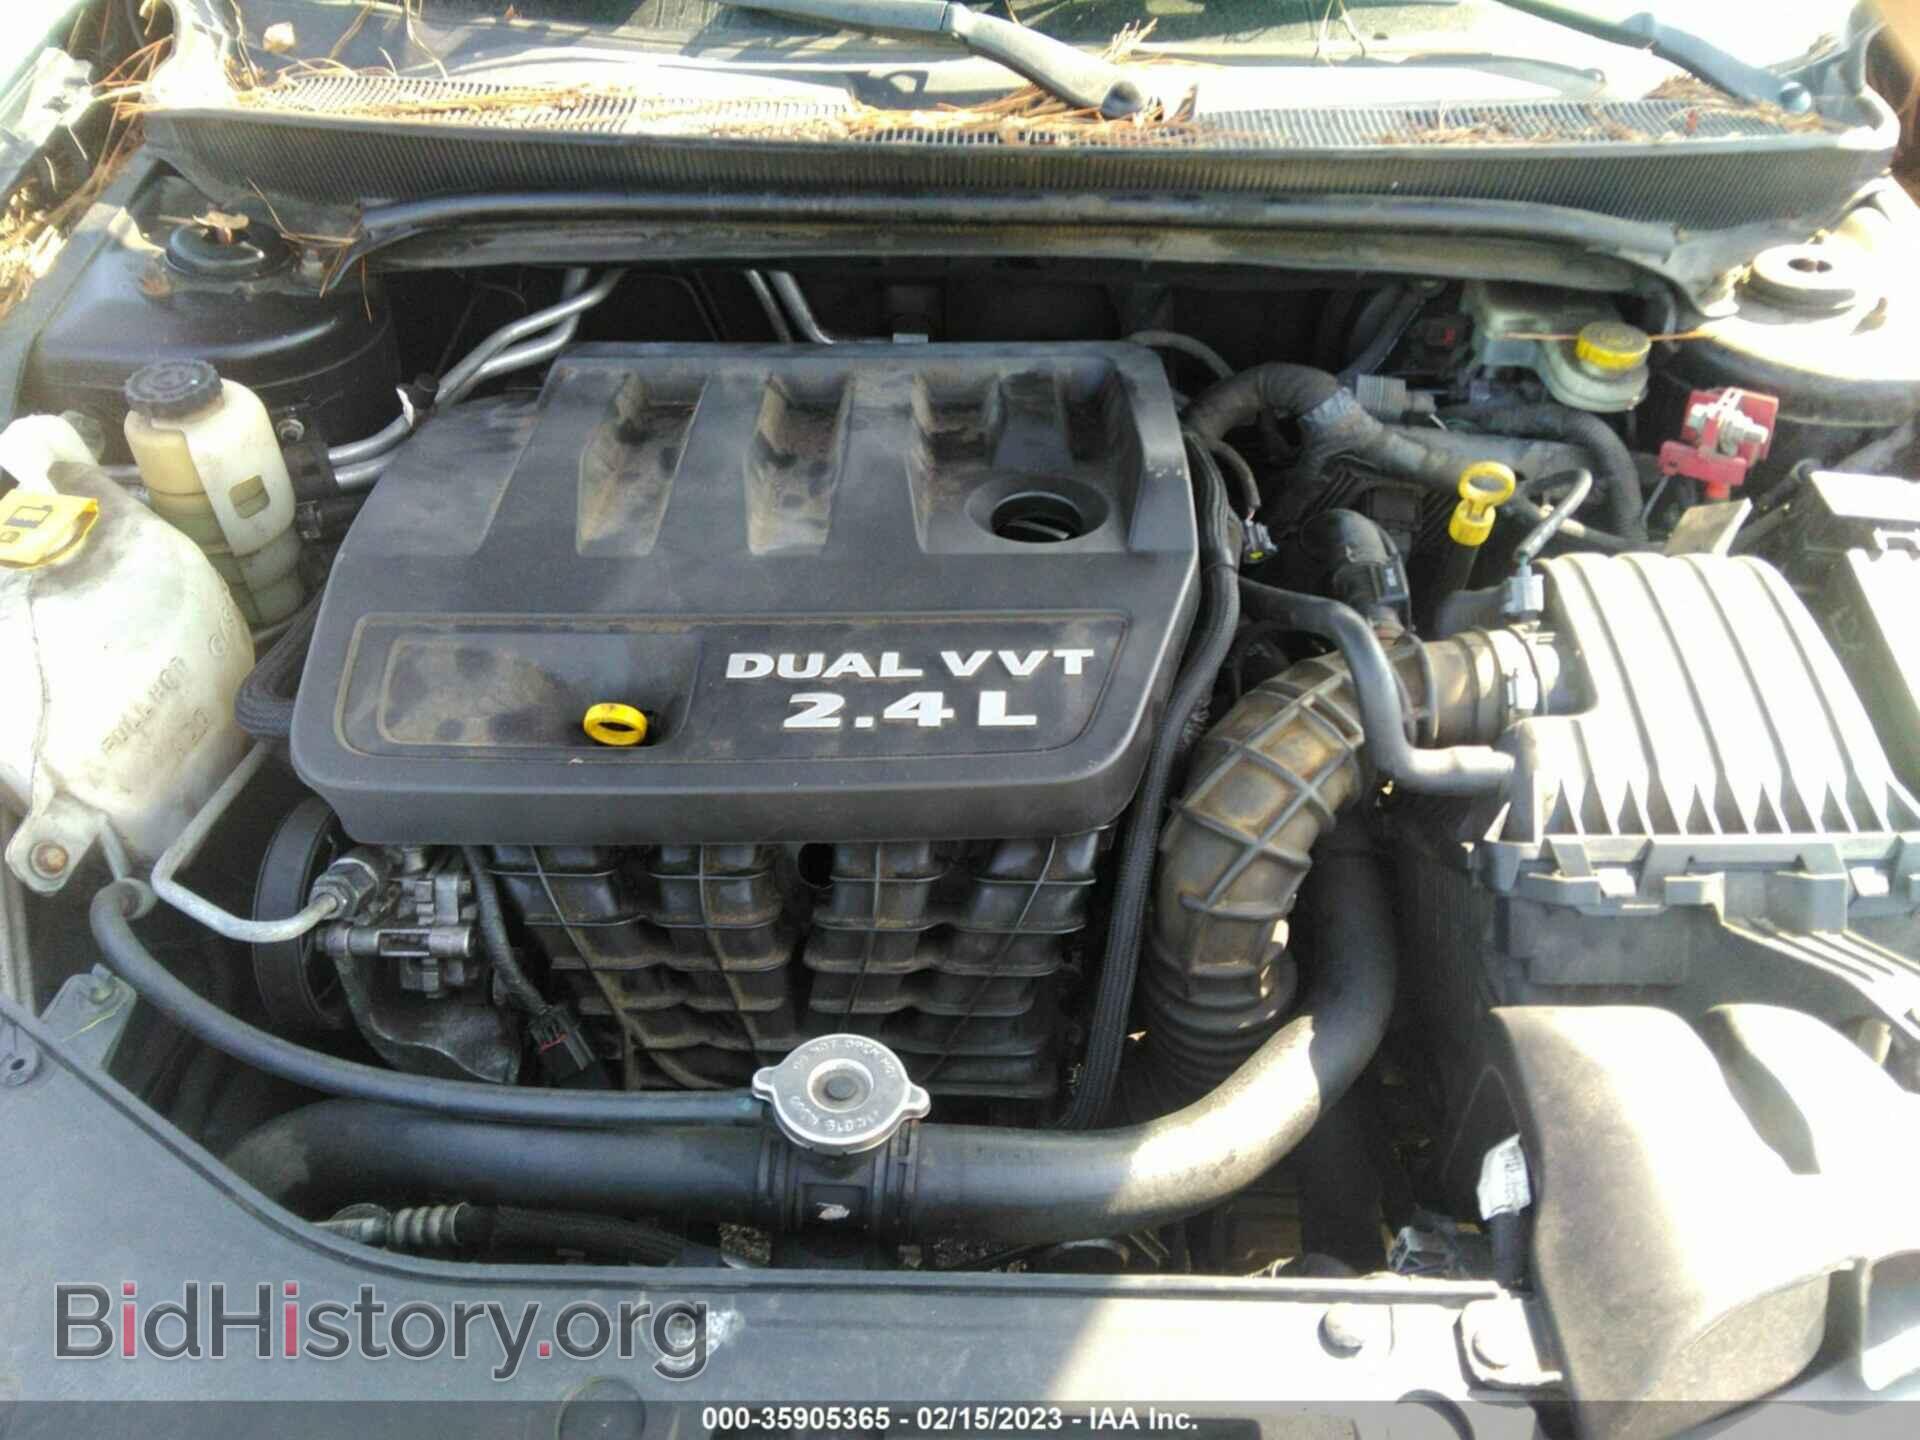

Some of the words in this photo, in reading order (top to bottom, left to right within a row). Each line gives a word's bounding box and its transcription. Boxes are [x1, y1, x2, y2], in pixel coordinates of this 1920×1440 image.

[725, 651, 924, 680] DUAL
[940, 649, 1095, 677] VVT
[782, 690, 955, 729] 2.4
[977, 690, 1038, 727] L
